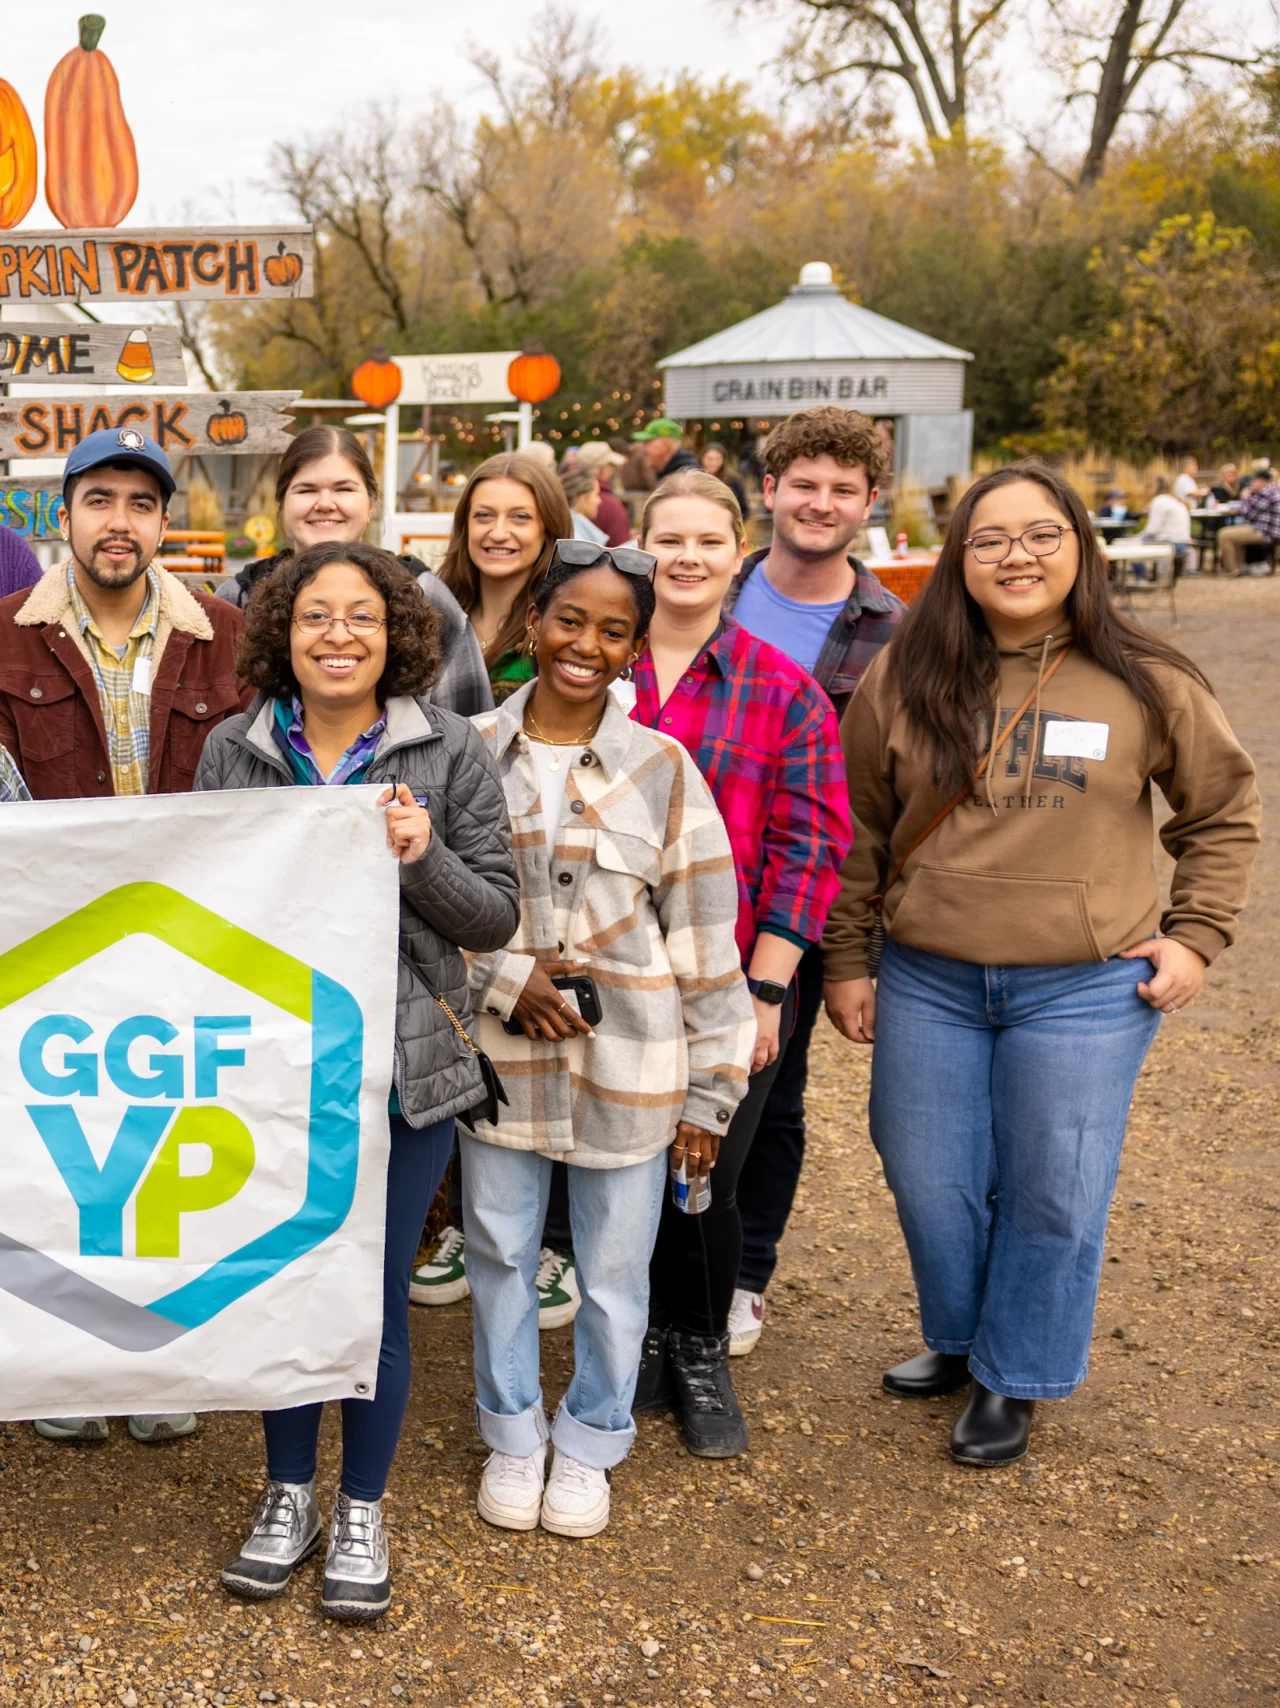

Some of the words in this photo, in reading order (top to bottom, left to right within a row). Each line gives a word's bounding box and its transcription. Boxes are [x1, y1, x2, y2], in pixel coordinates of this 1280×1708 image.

[112, 240, 261, 296] PATCH
[714, 379, 781, 401] GRAIN
[789, 377, 830, 400] BIN
[839, 376, 888, 399] BAR
[967, 796, 1064, 808] EATHER
[19, 1013, 251, 1099] GGF
[24, 1104, 256, 1258] YP
